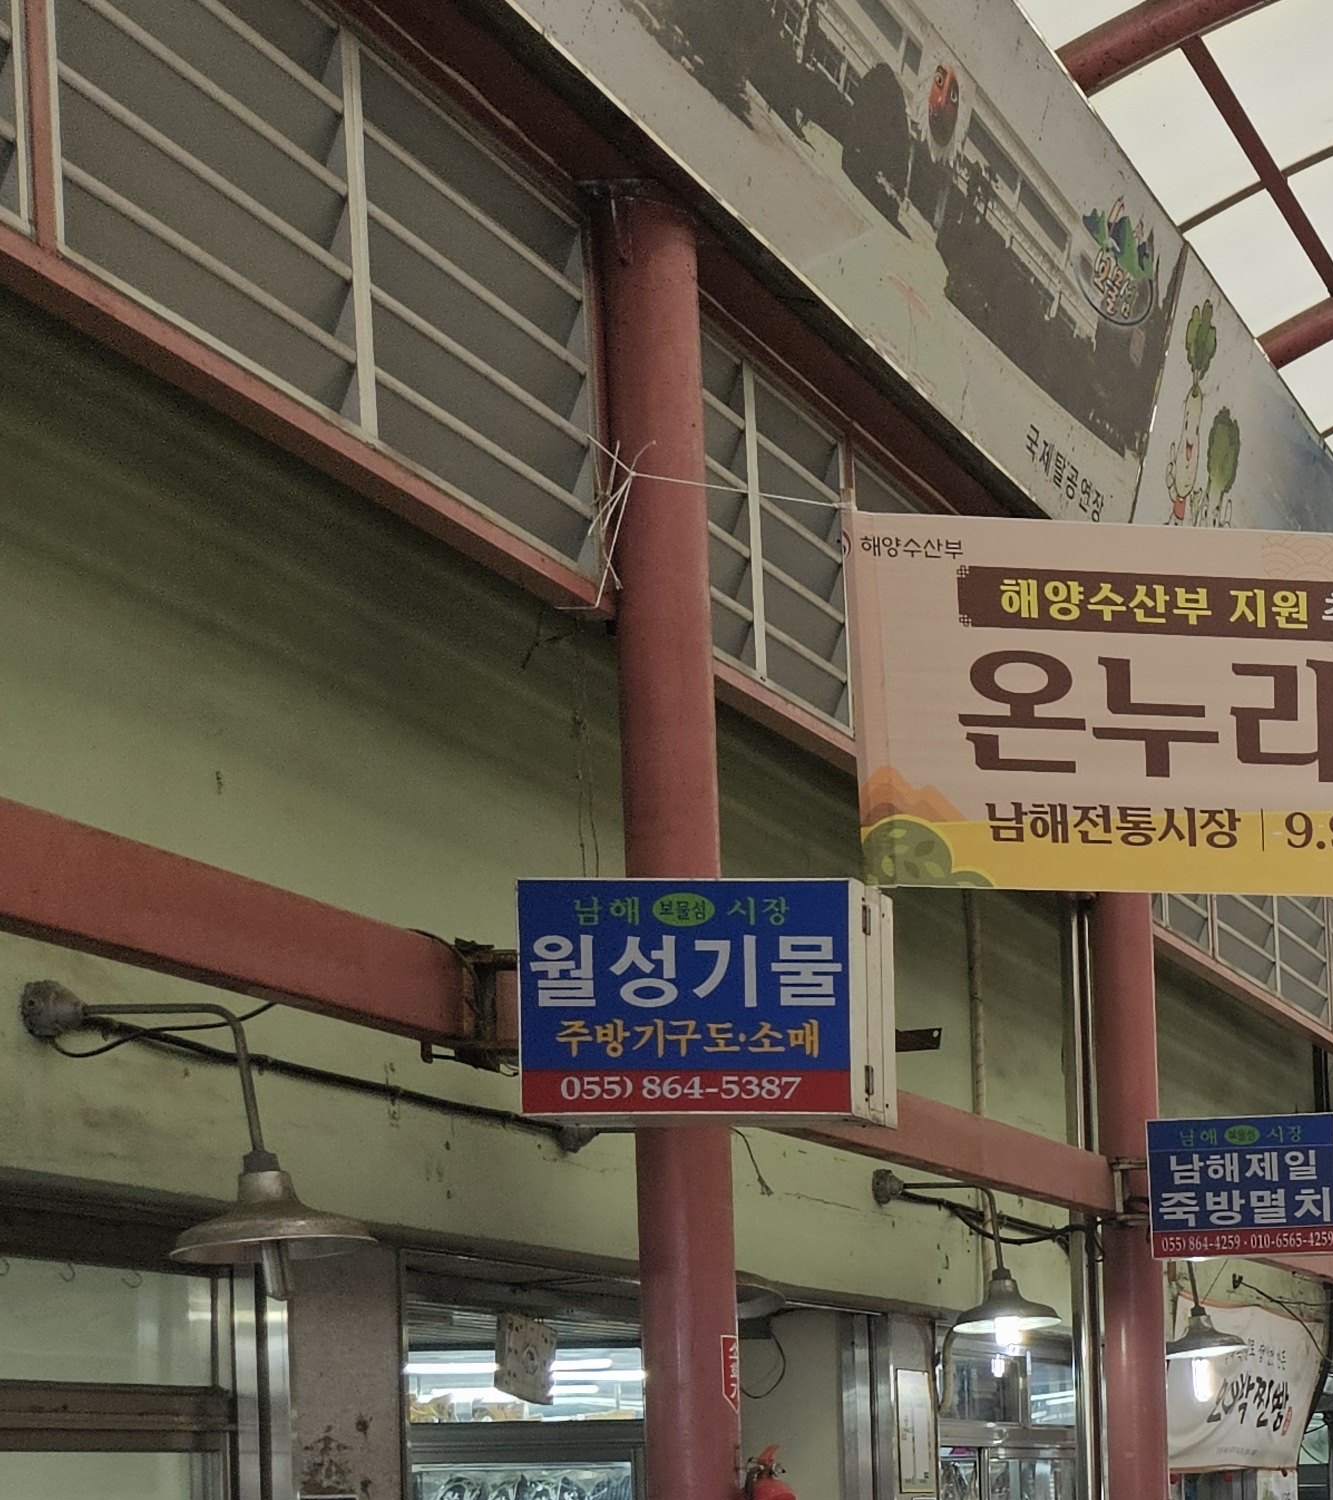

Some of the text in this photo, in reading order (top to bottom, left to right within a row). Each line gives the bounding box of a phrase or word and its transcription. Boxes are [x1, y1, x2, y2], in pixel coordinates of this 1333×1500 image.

[860, 534, 964, 560] 해양수산부
[1000, 577, 1213, 627] 해양수산부
[1230, 588, 1309, 631] 지원
[985, 801, 1241, 849] 남해전통시장
[574, 896, 640, 926] 남해
[726, 896, 790, 926] 시장
[529, 933, 843, 1008] 월성기물
[560, 1075, 803, 1100] 055) 864-5387
[1169, 1149, 1319, 1186] 남해제일
[1158, 1186, 1332, 1228] 죽방멸치
